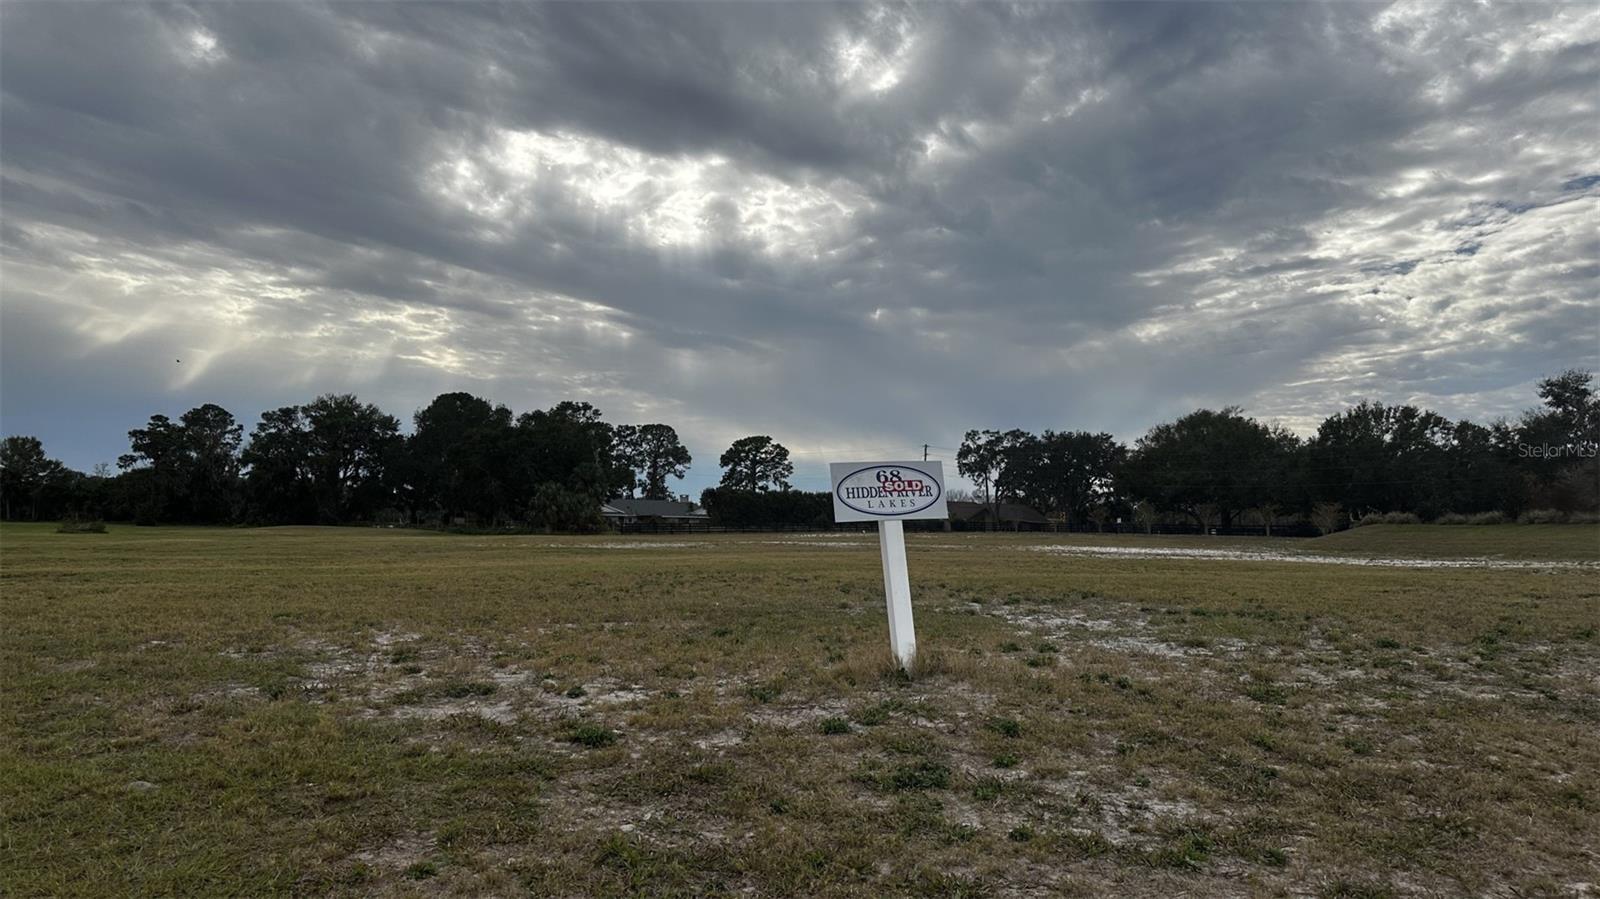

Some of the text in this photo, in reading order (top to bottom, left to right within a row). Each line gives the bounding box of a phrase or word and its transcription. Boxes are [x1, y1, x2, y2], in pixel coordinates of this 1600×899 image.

[876, 470, 902, 484] 68
[884, 481, 922, 491] SOLD
[846, 486, 893, 499] HIDDEN
[868, 499, 915, 508] LAKES
